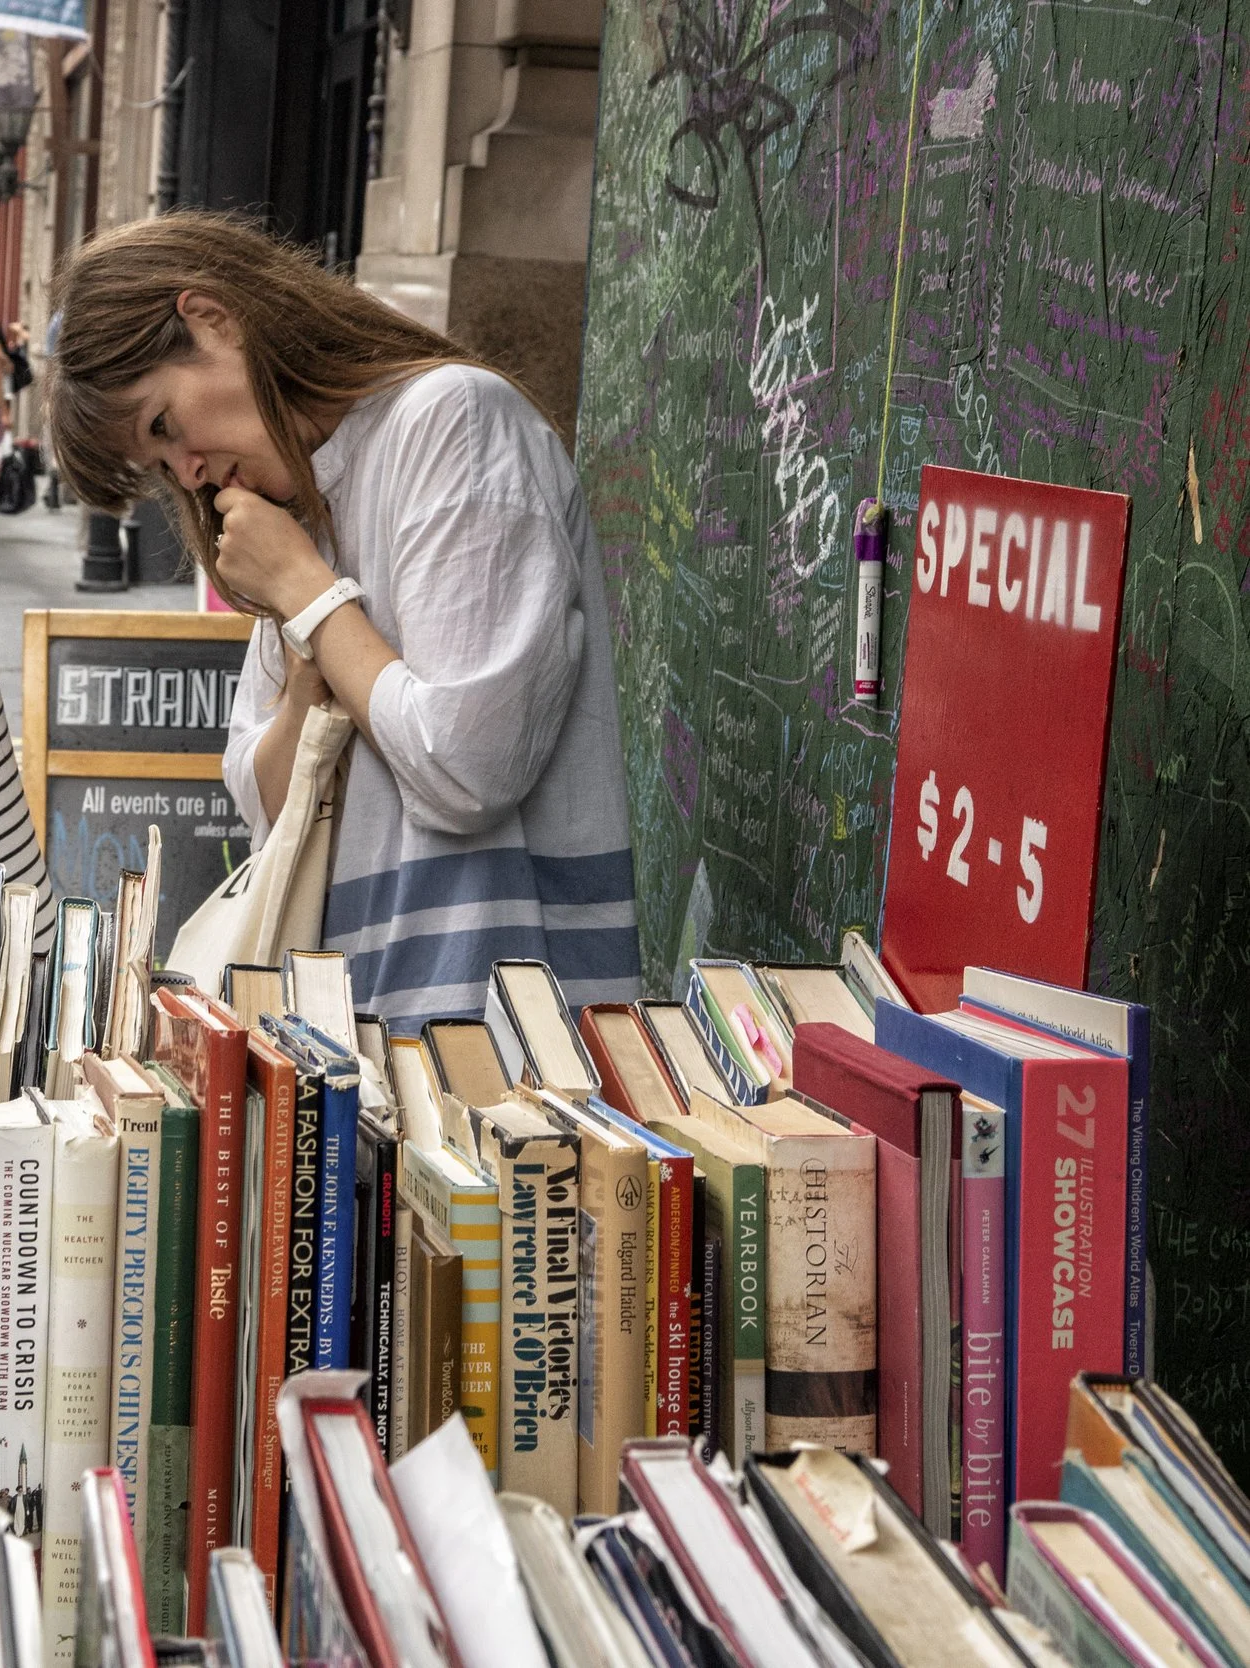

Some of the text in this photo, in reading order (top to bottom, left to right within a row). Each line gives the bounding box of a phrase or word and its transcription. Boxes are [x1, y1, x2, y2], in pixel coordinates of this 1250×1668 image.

[916, 499, 1101, 632] SPECIAL
[82, 786, 228, 816] All events are in
[194, 823, 252, 838] unless othe
[3, 1160, 14, 1179] THE
[120, 1117, 158, 1133] Trent
[2, 1184, 13, 1227] COMING
[76, 1215, 94, 1224] THE
[124, 1148, 150, 1243] EIGHTY
[210, 1091, 233, 1321] THE BEST OF Taste
[270, 1084, 290, 1299] CREATIVE NEEDLEWORK
[292, 1084, 318, 1280] A FASHION FOR
[381, 1172, 392, 1237] GRANDITS
[1056, 1083, 1097, 1298] 27 ILLUSTRATION
[1129, 1098, 1144, 1308] The Viking Children's World Atlas
[1, 1232, 12, 1281] NUCLEAR
[64, 1235, 105, 1244] HEALTHY
[64, 1256, 104, 1265] KITCHEN
[319, 1134, 340, 1358] THE JOHN F. KENNEDYS BY
[512, 1162, 546, 1307] Lawrence
[669, 1186, 682, 1293] ANDERSON/PINNEO
[740, 1193, 758, 1330] YEARBOOK
[805, 1160, 828, 1347] HISTORIAN
[980, 1209, 991, 1305] PETER CALLAHAN
[1052, 1157, 1076, 1351] SHOWCASE
[0, 1286, 11, 1348] SHOWDOWN
[14, 1159, 40, 1411] COUNTDOWN TO CRISIS
[121, 1249, 147, 1368] PRECIOUS
[395, 1246, 408, 1403] BUOY HOME AT SEA
[546, 1163, 578, 1421] No Final Victories
[617, 1231, 637, 1335] Edgard Haider
[669, 1302, 679, 1318] the
[702, 1243, 714, 1378] POLITICALLY CORRECT
[0, 1352, 10, 1381] WITH
[62, 1371, 98, 1379] RECIPES
[376, 1281, 391, 1446] TECHNICALLY, IT'S NOT
[668, 1322, 686, 1349] ski
[116, 1374, 143, 1484] CHINESE
[668, 1356, 686, 1413] house
[967, 1328, 1003, 1528] bite by bite
[63, 1430, 93, 1438] SPIRIT
[263, 1434, 279, 1490] Springer
[51, 1552, 76, 1561] WEIL,
[162, 1532, 172, 1575] KINSHIP
